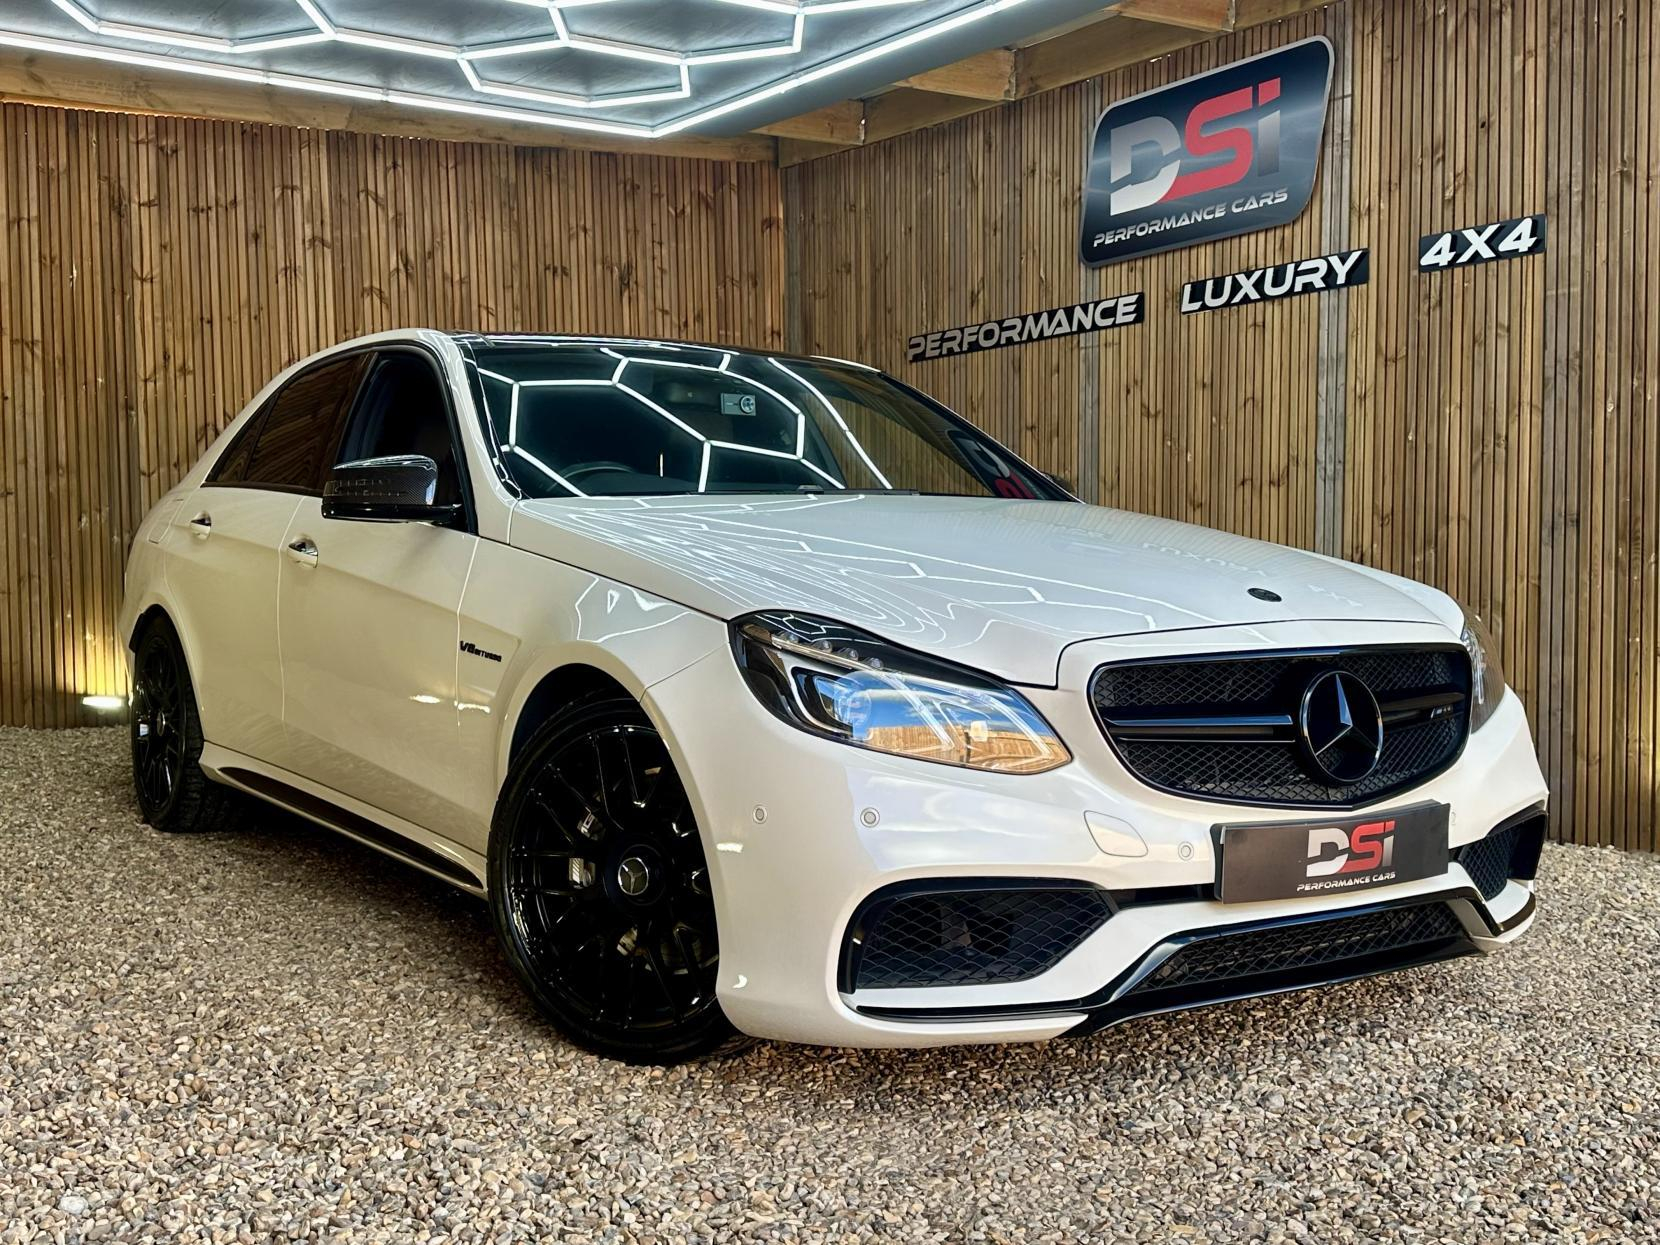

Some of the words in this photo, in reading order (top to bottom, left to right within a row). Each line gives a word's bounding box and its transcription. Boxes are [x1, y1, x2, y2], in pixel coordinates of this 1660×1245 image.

[1093, 202, 1227, 248] PERFORMANCE
[1231, 187, 1289, 214] CARS
[1419, 217, 1538, 267] 4X4
[1180, 250, 1365, 314] LUXURY
[907, 294, 1140, 362] PERFORMANCE
[459, 640, 475, 654] V8
[1296, 875, 1371, 892] PERFORMANCE
[1372, 871, 1396, 882] CARS
